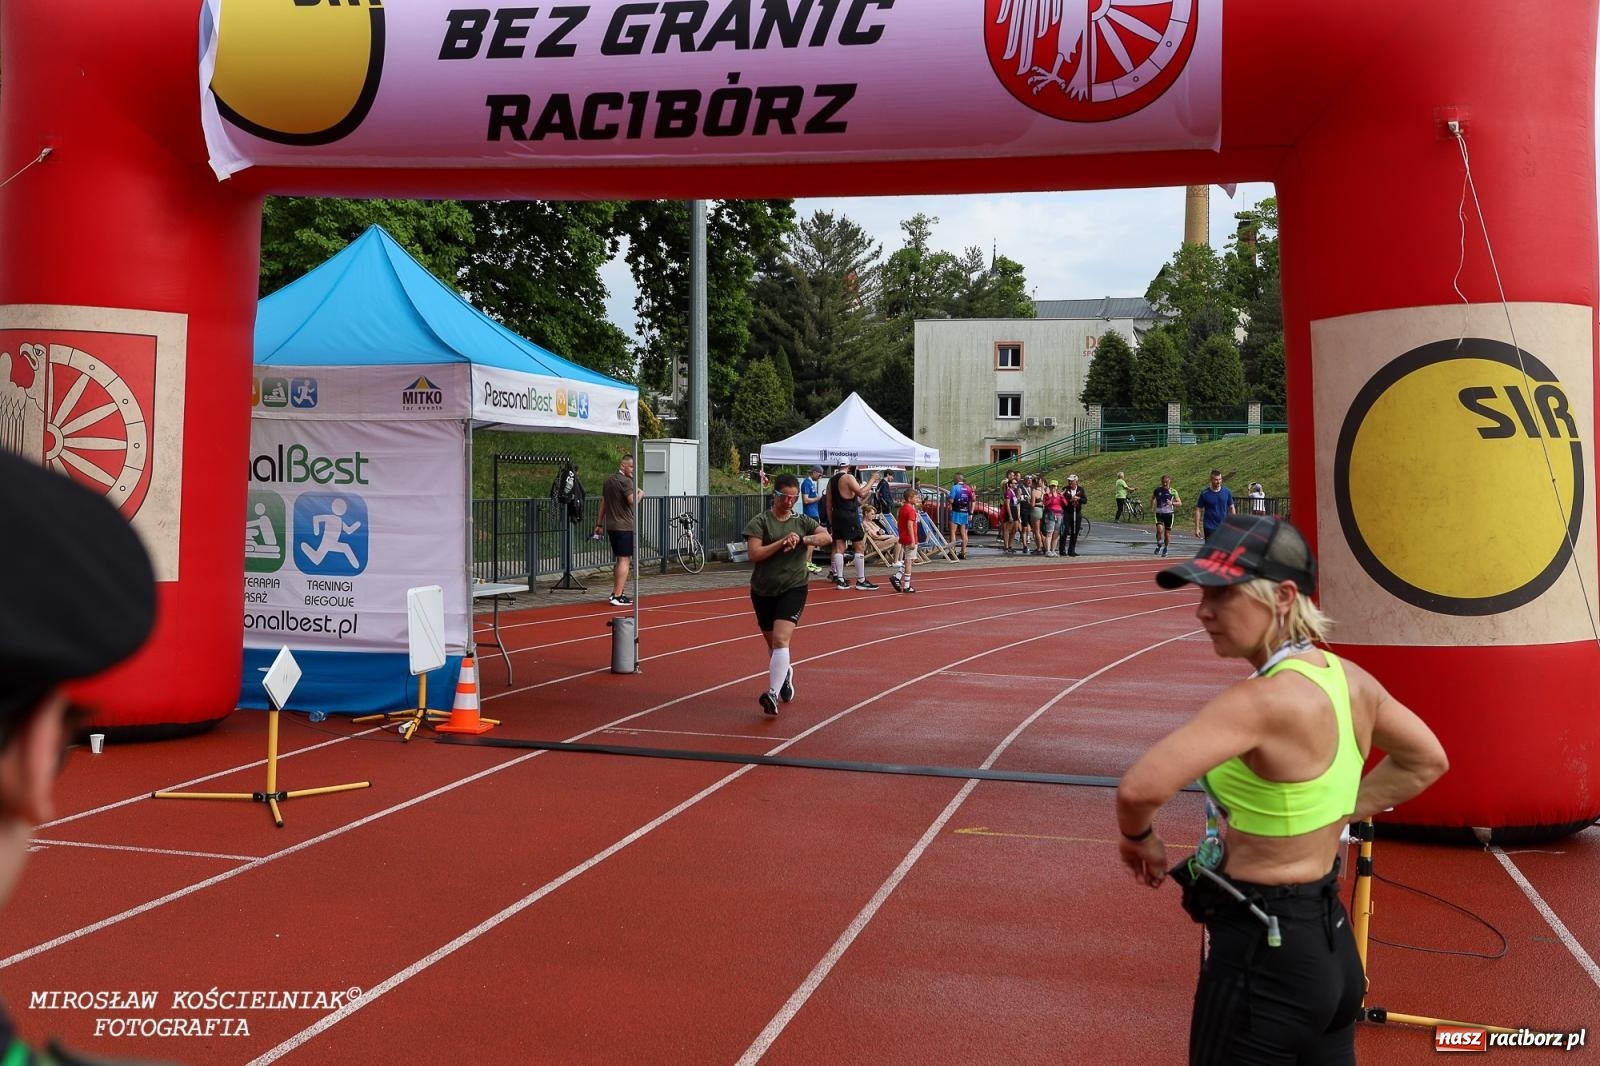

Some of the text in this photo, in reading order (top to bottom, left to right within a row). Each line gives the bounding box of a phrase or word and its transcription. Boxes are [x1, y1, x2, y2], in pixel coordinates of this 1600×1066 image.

[438, 0, 895, 60] BEZ GRANIC
[485, 72, 858, 142] RACIBÓRZ
[402, 391, 442, 405] MITKO
[484, 381, 553, 412] PersonalBest
[1458, 384, 1579, 439] SIR
[304, 595, 355, 608] BIEGOWE
[307, 580, 353, 592] TRENINGI
